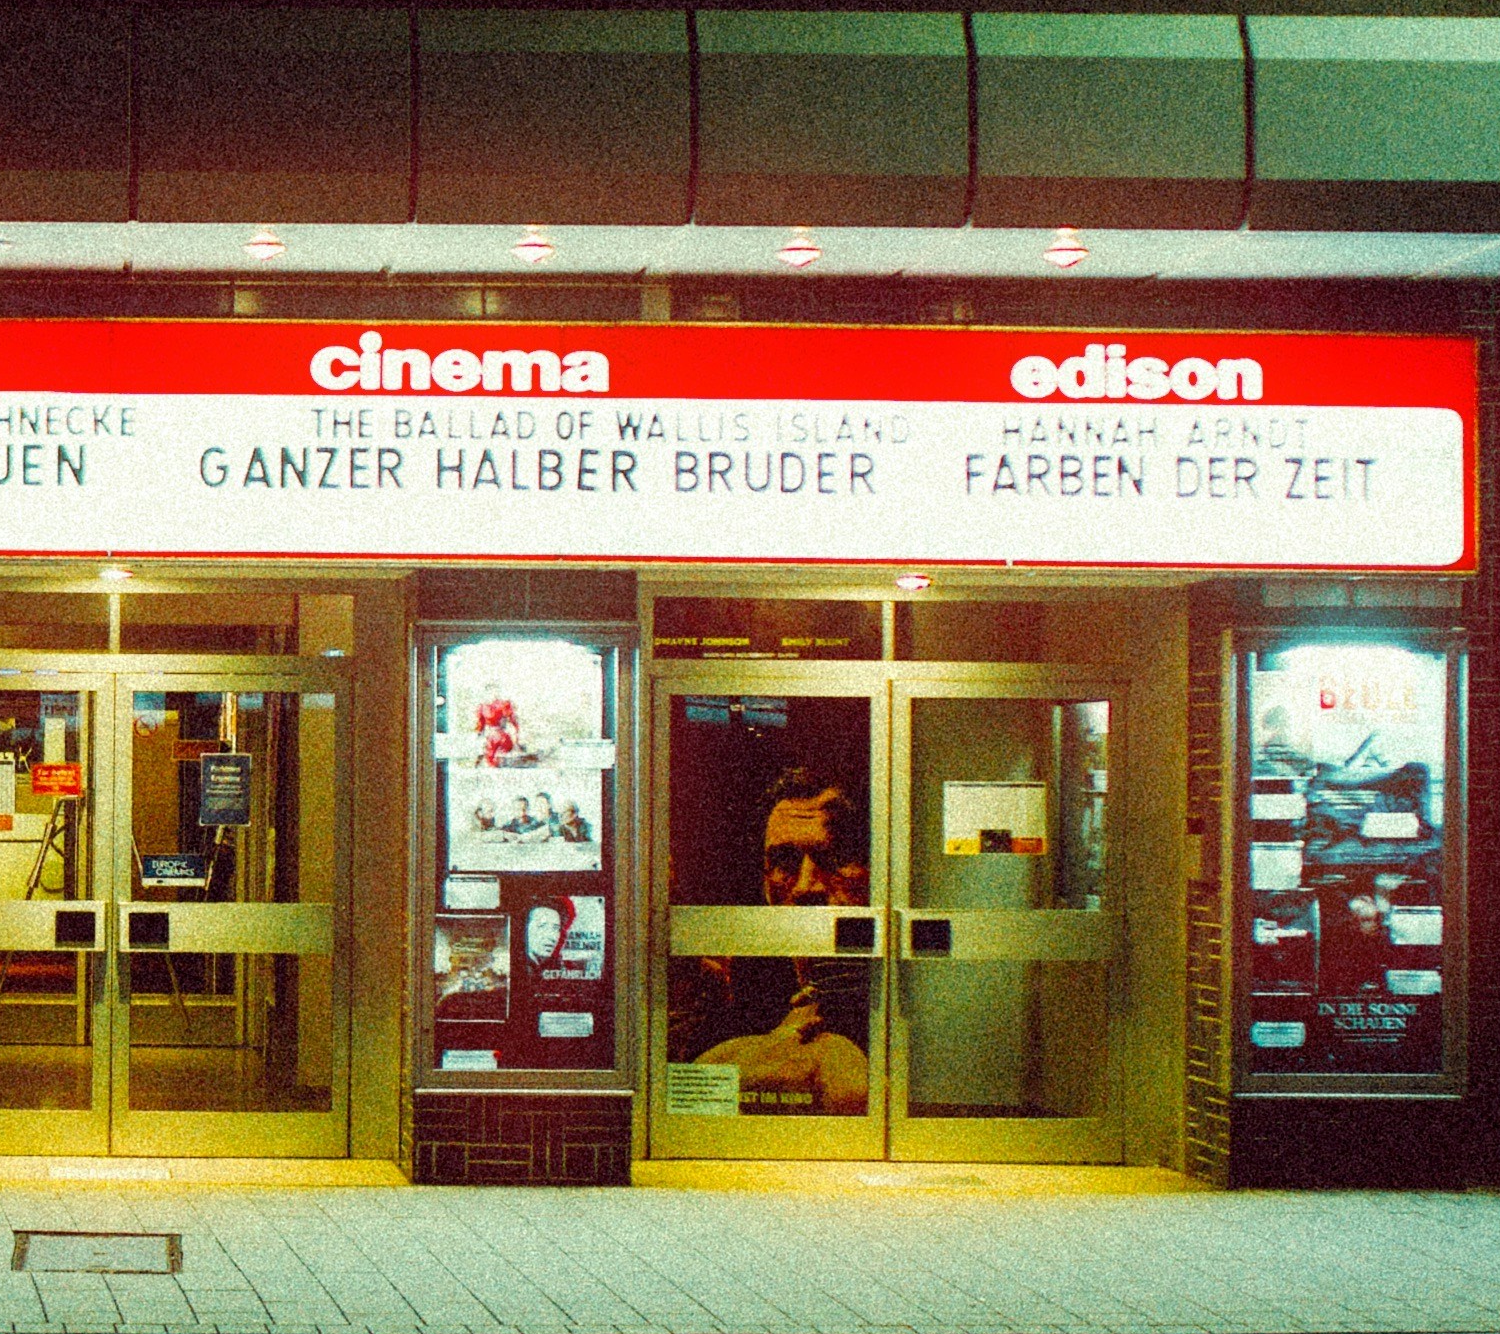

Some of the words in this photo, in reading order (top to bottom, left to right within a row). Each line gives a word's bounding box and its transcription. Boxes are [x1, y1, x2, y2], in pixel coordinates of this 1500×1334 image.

[309, 330, 610, 393] cinema
[1009, 343, 1264, 400] edison
[310, 408, 373, 439] THE
[394, 410, 537, 440] BALLAD
[556, 410, 594, 441] OF
[617, 412, 751, 444] WALLIS
[1001, 417, 1159, 446] HANNAH
[199, 445, 405, 490] GANZER
[436, 447, 640, 493] HALBER
[675, 451, 876, 495] BRUDER
[965, 453, 1145, 497] FARBEN
[1176, 457, 1258, 498] DER
[1285, 457, 1377, 501] ZEIT
